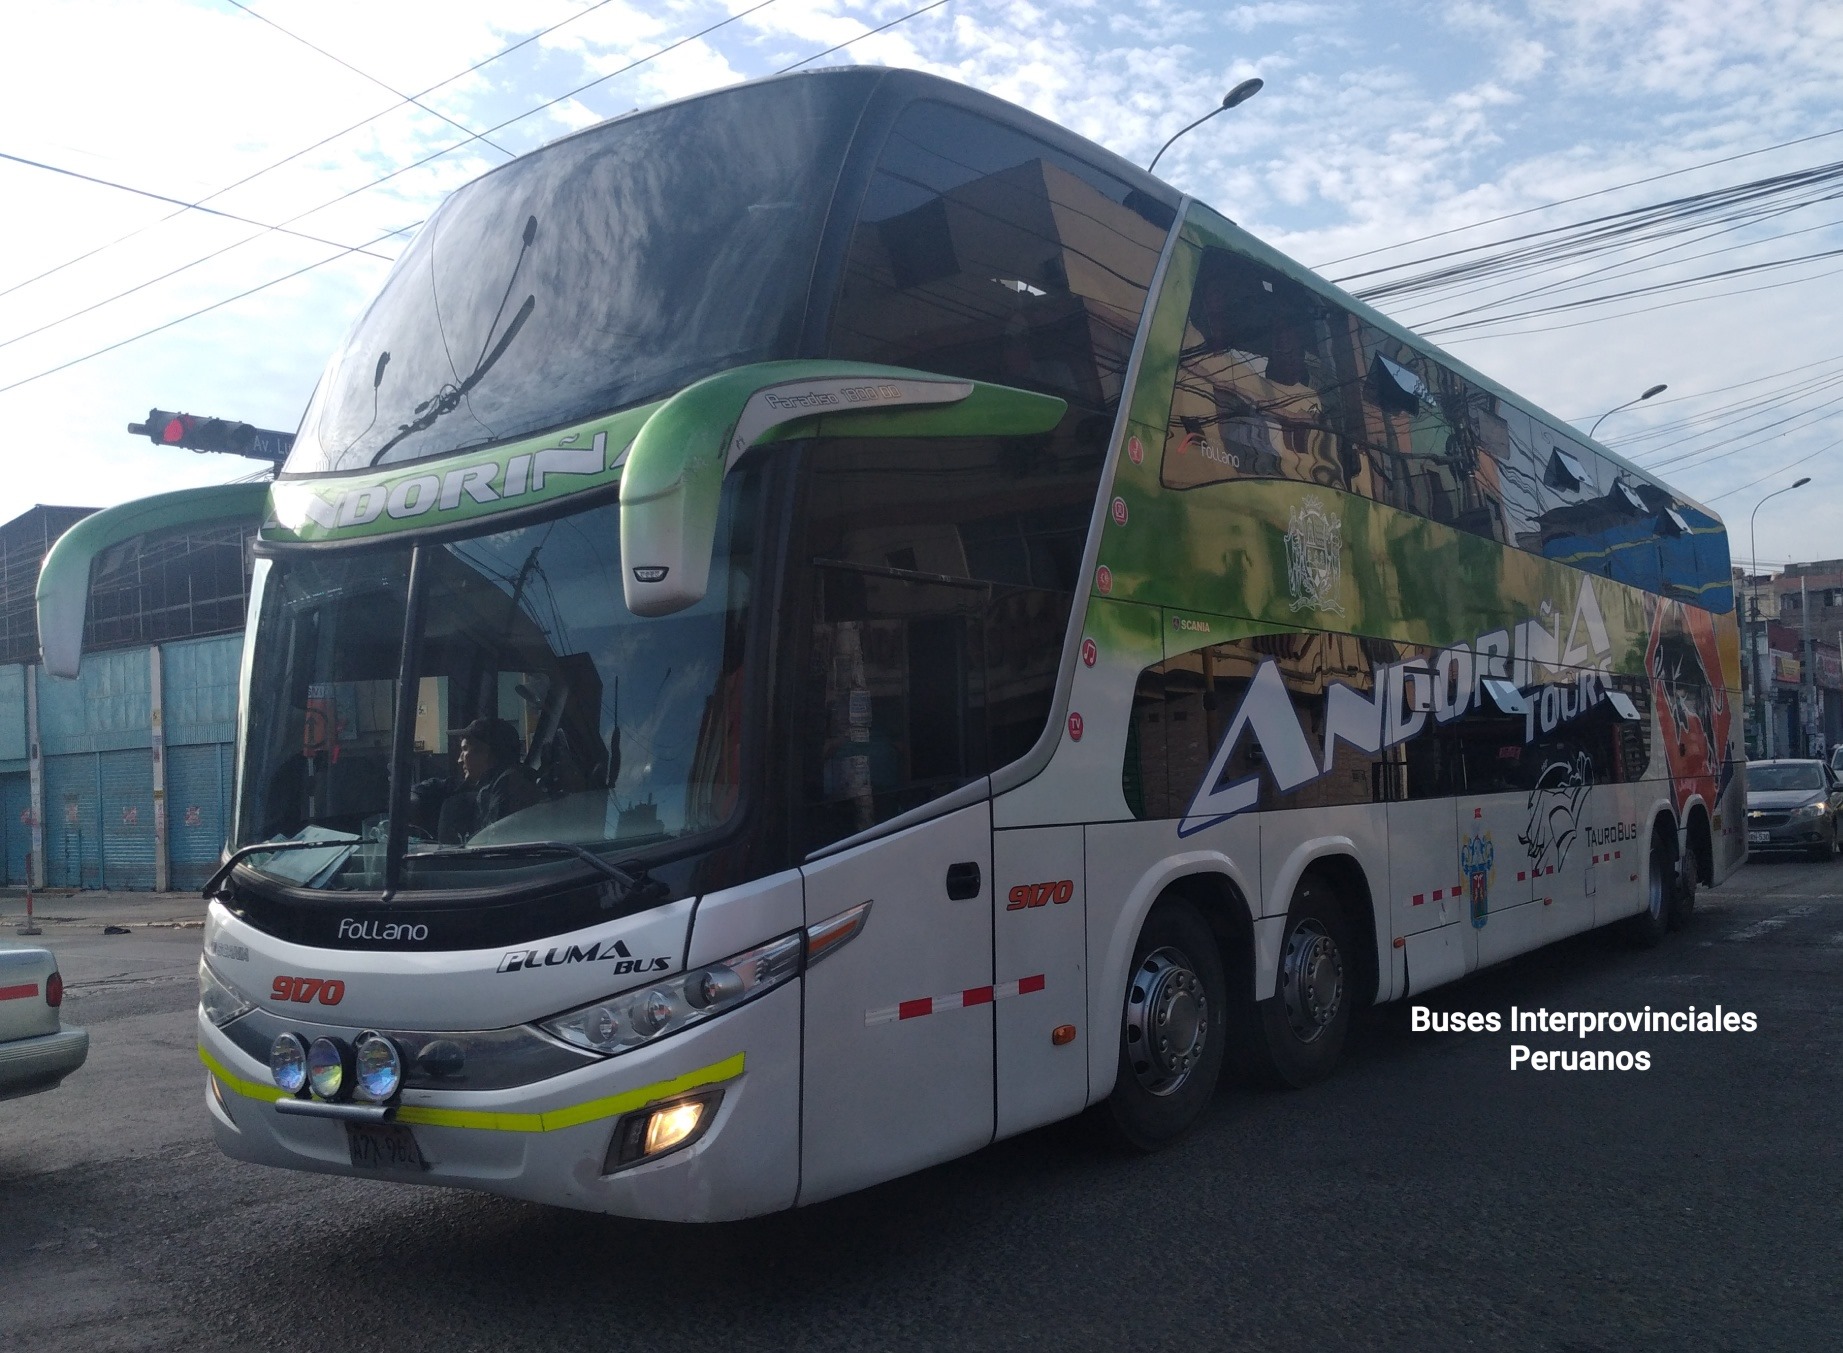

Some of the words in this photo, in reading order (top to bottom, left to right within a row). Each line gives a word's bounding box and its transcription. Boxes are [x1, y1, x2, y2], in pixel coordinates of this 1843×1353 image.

[764, 390, 839, 409] Paradiso
[841, 386, 879, 403] 1800
[253, 435, 272, 453] Av.
[1180, 619, 1211, 633] SCANIA
[1178, 571, 1611, 839] ANDORIÑA
[1070, 718, 1081, 730] TV
[1006, 879, 1074, 911] 9170
[496, 940, 632, 973] PLUMA
[613, 957, 672, 975] BUS
[270, 975, 345, 1006] 9170
